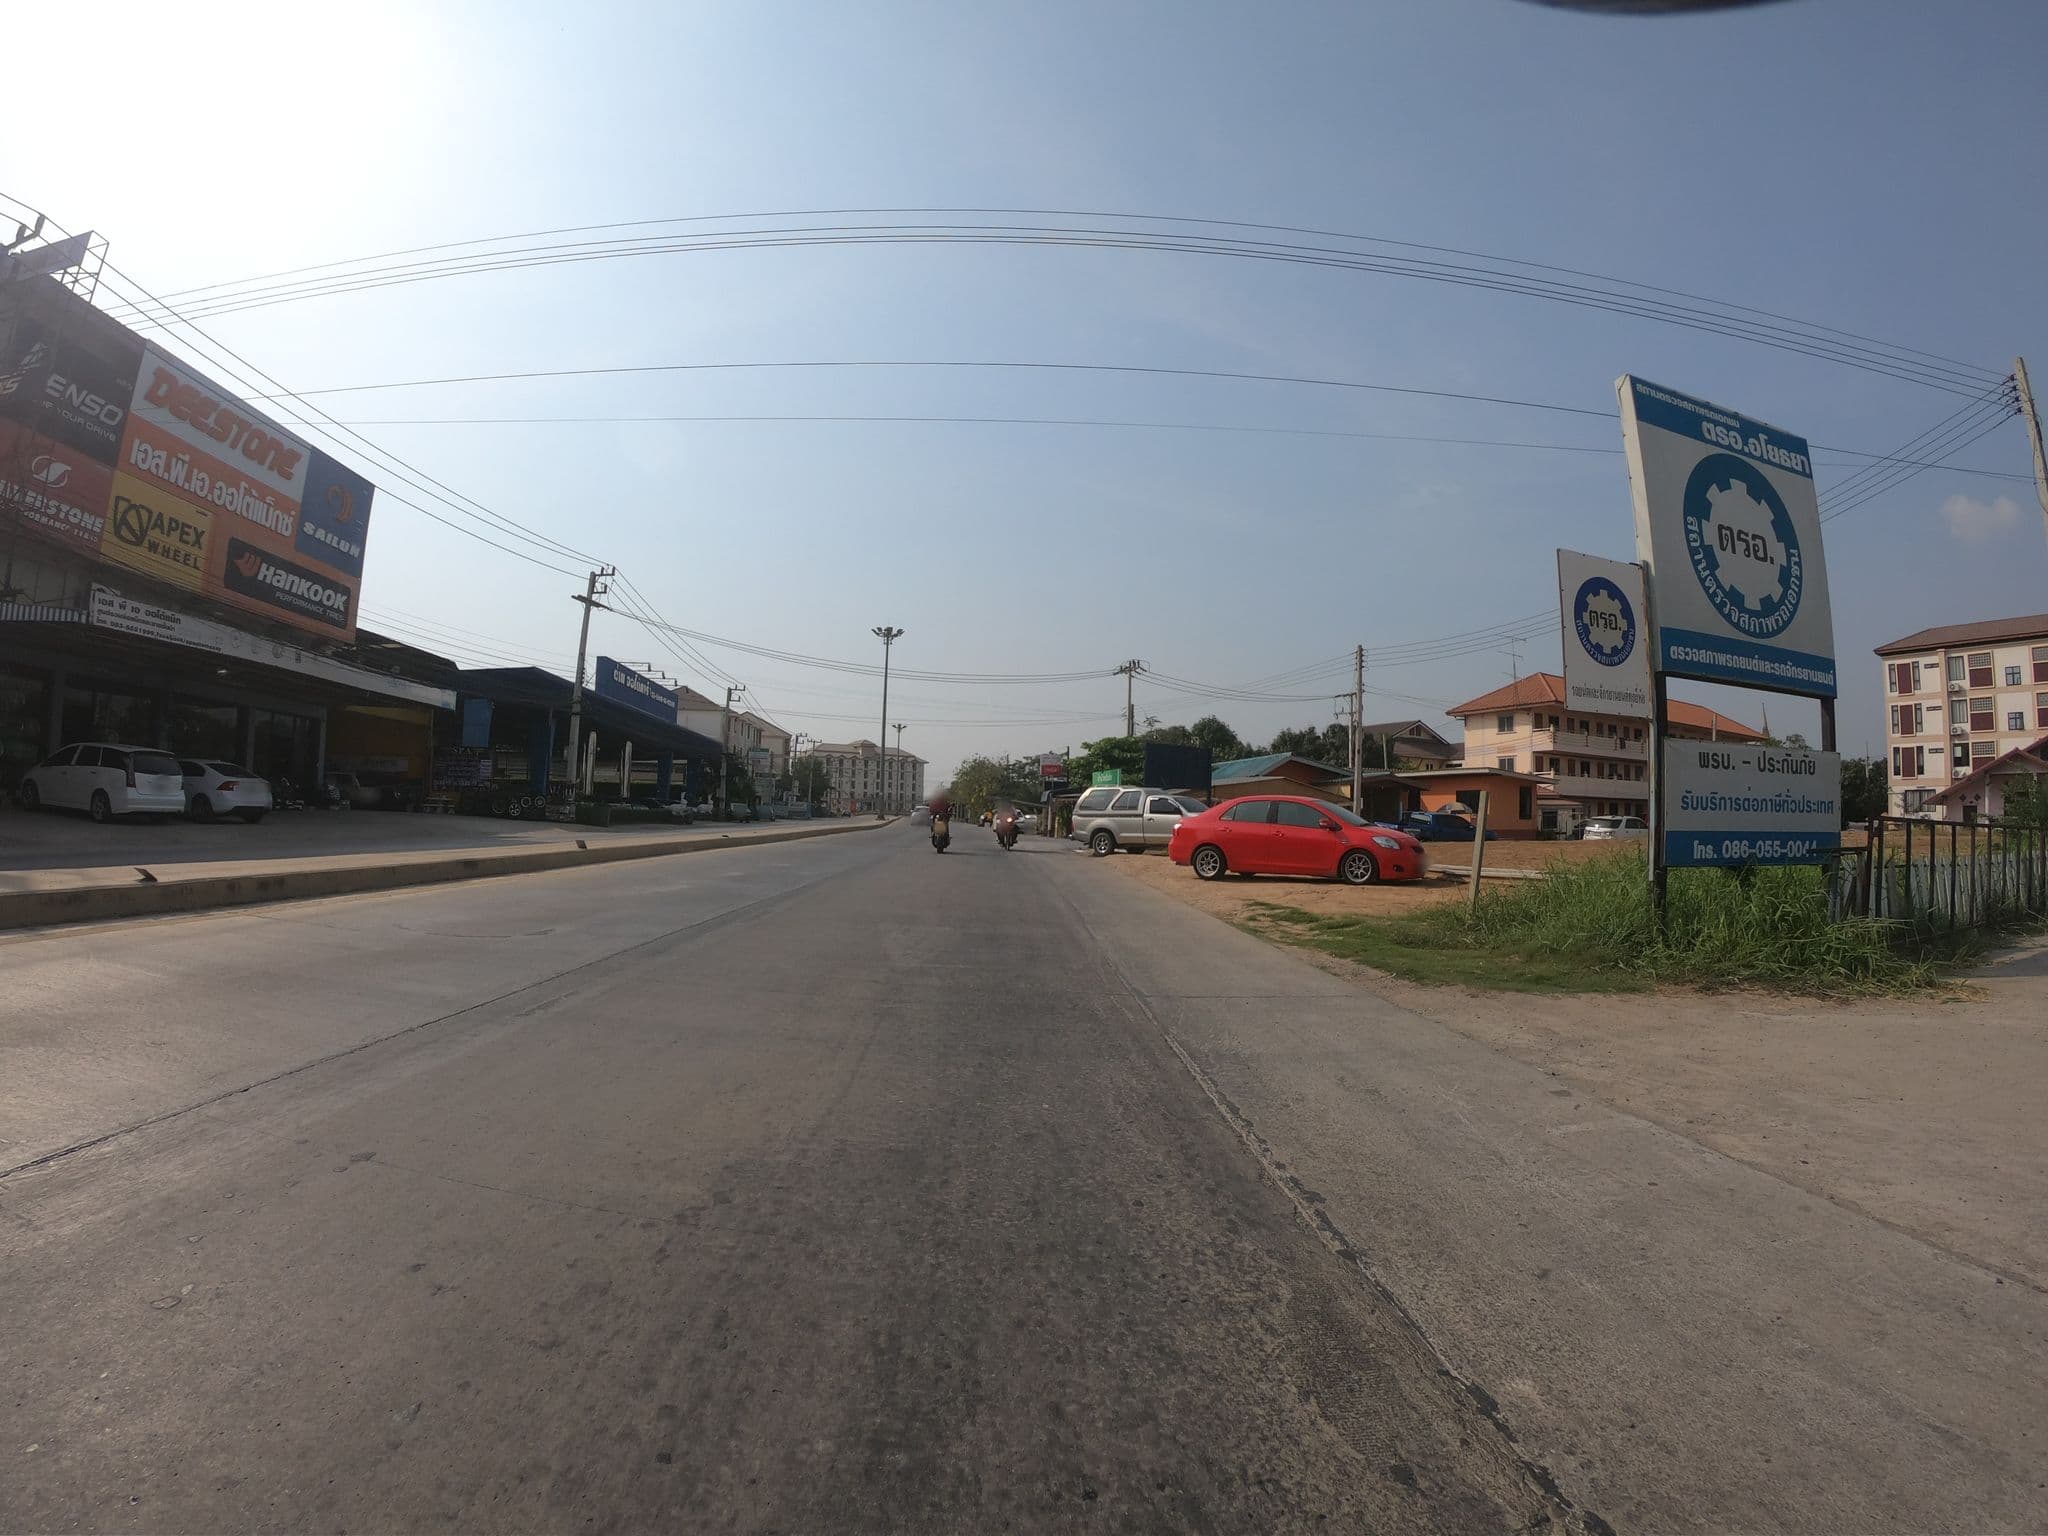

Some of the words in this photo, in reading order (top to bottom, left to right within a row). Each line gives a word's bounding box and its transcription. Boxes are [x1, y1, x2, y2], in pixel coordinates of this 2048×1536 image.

[150, 512, 206, 550] APEX
[303, 521, 360, 558] SAILUN
[1717, 523, 1775, 565] ตรอ.
[147, 539, 202, 571] WHEEL
[1686, 515, 1801, 634] สถานตรวจสภาพรถเอกชน
[1589, 609, 1622, 631] ตรอ.
[1670, 645, 1834, 687] ตรวจสภาพรถยนต์และรถจักรยานยนต์
[1698, 751, 1736, 771] พรบ.
[1757, 750, 1816, 776] ประกันภัย
[1680, 785, 1835, 814] รับบริการต่อภาษีทั่วประเทศ
[1693, 839, 1718, 860] โทร.
